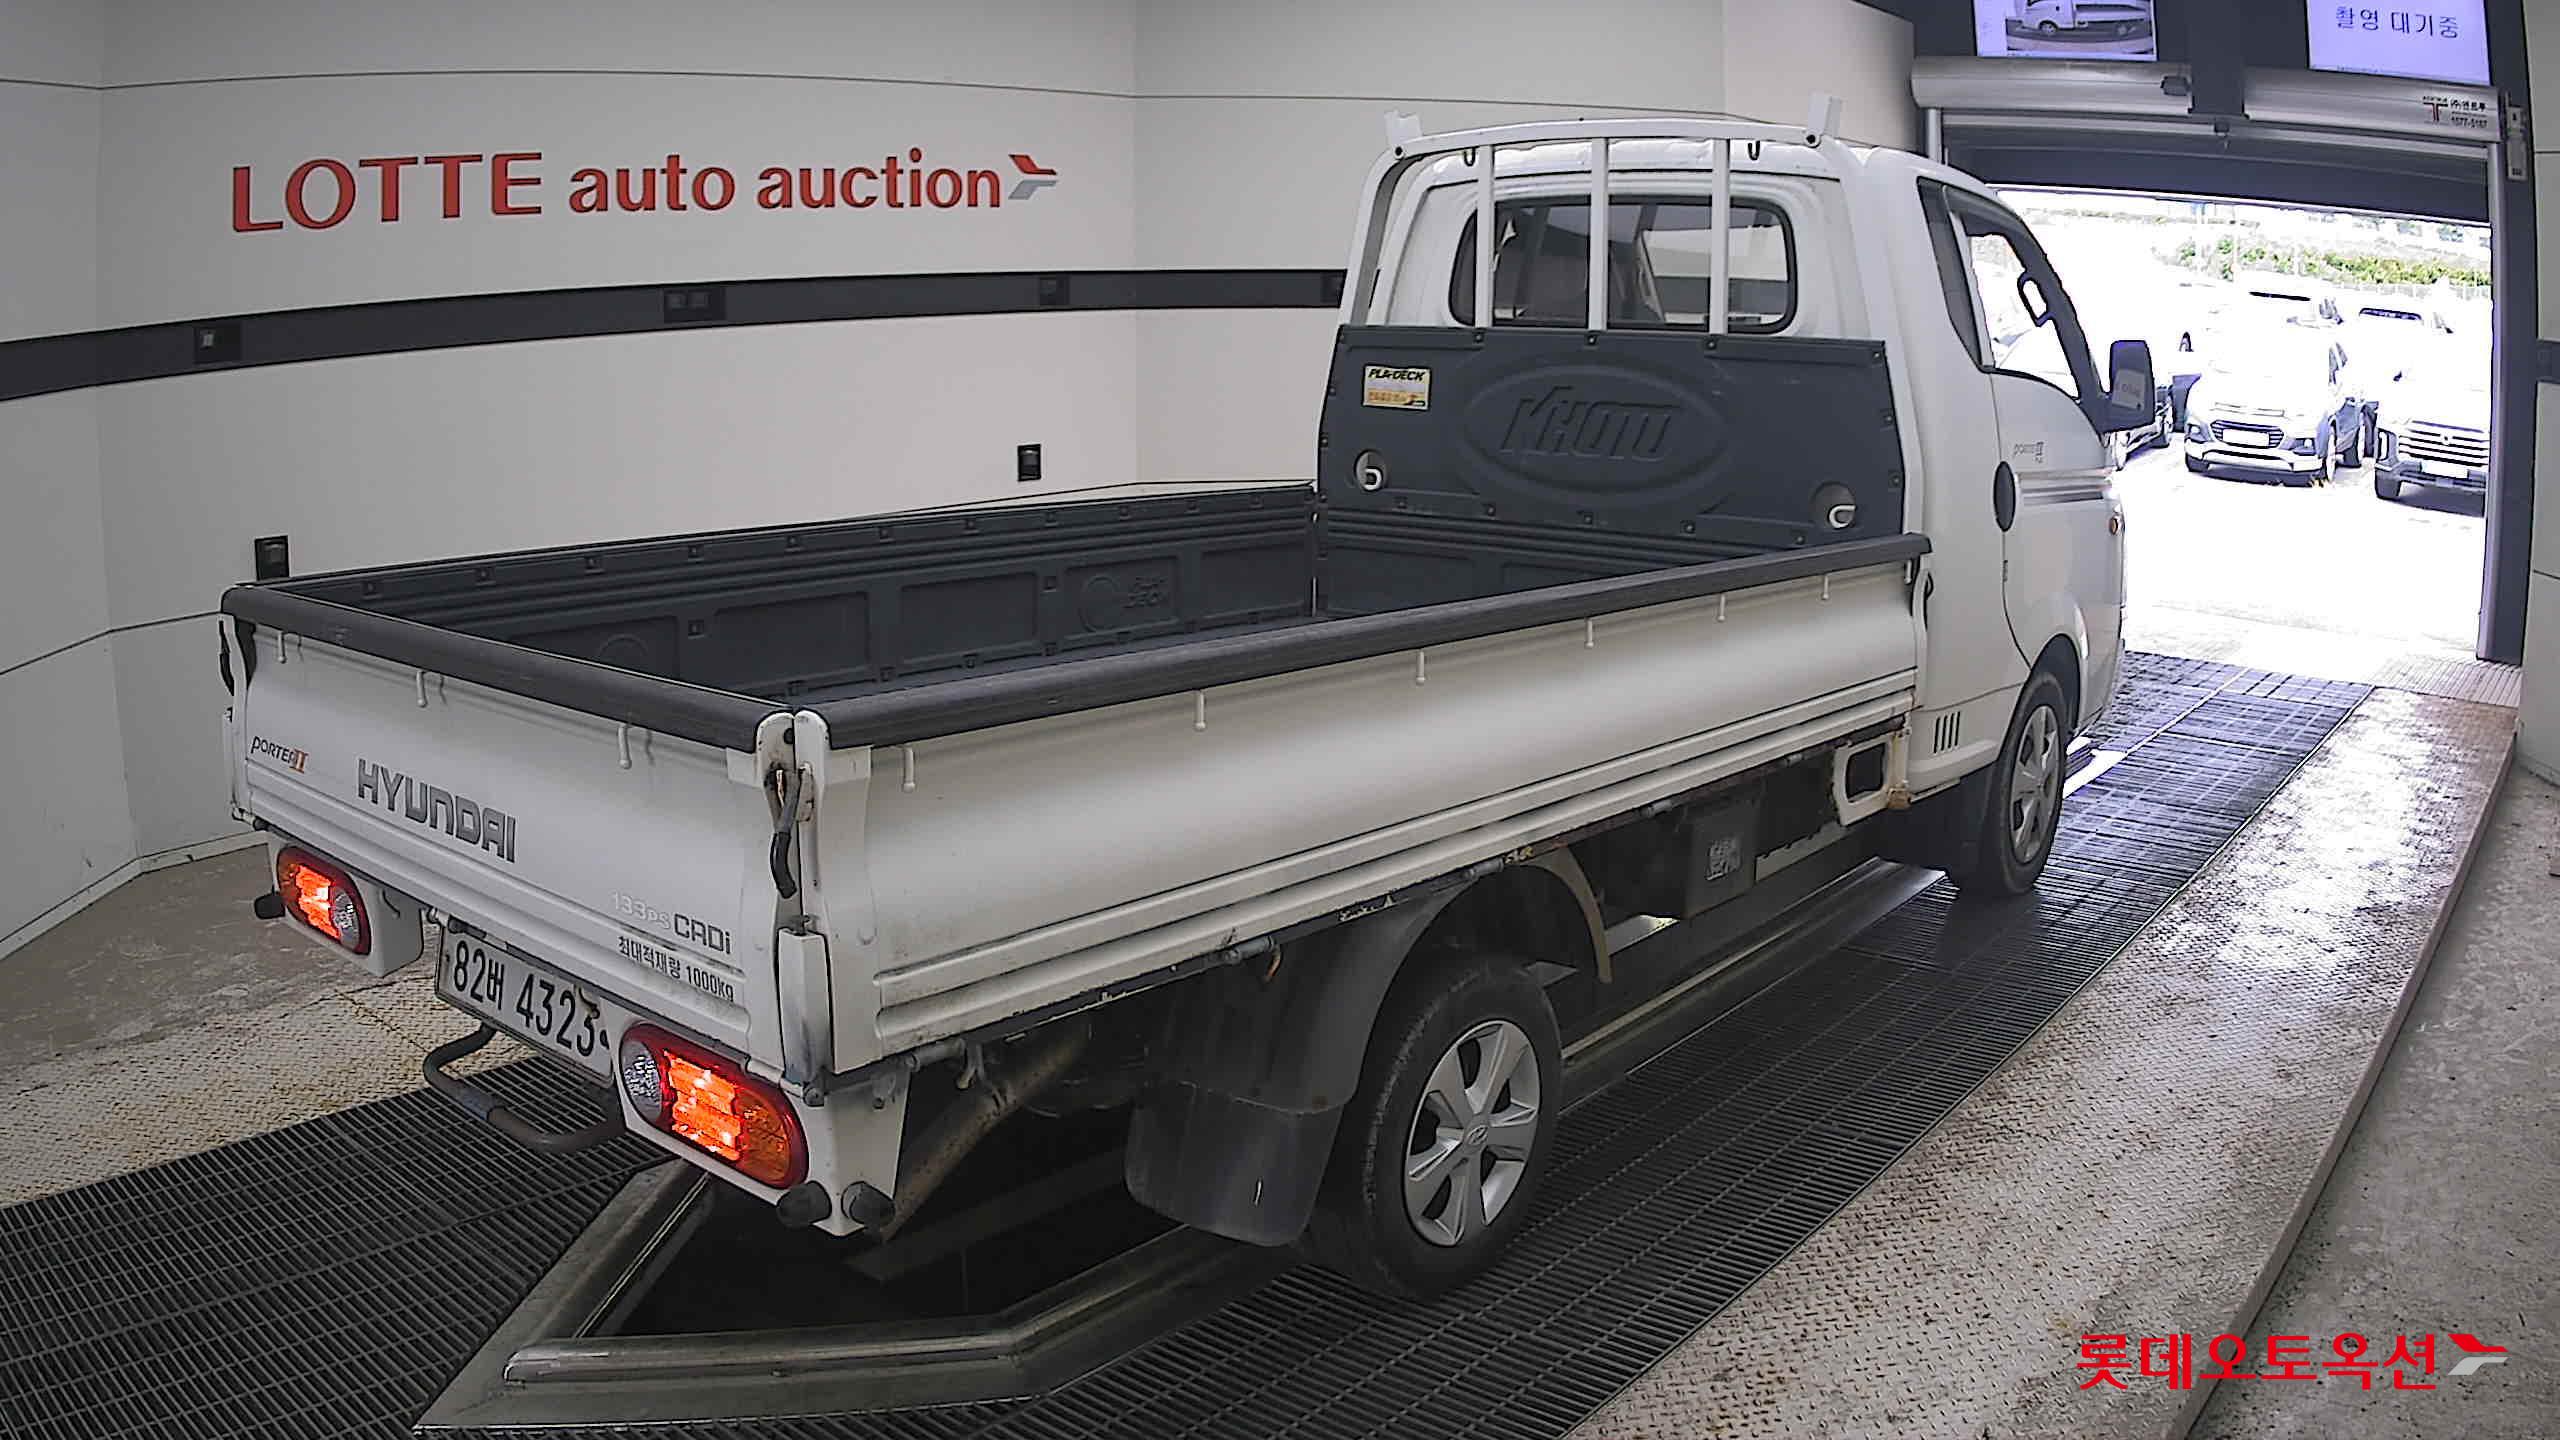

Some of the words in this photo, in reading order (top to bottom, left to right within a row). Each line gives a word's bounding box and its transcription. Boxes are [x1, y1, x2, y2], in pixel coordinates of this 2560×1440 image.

[2335, 5, 2379, 31] 촬영
[2391, 12, 2458, 39] 대기중
[231, 151, 543, 233] LOTTE
[567, 154, 736, 214] auto
[756, 147, 1001, 210] auction
[357, 758, 517, 864] HYUNDAI
[453, 940, 505, 1011] 82버
[516, 973, 599, 1057] 4323
[618, 936, 681, 979] 최대적재량
[686, 965, 734, 1002] 1000kg
